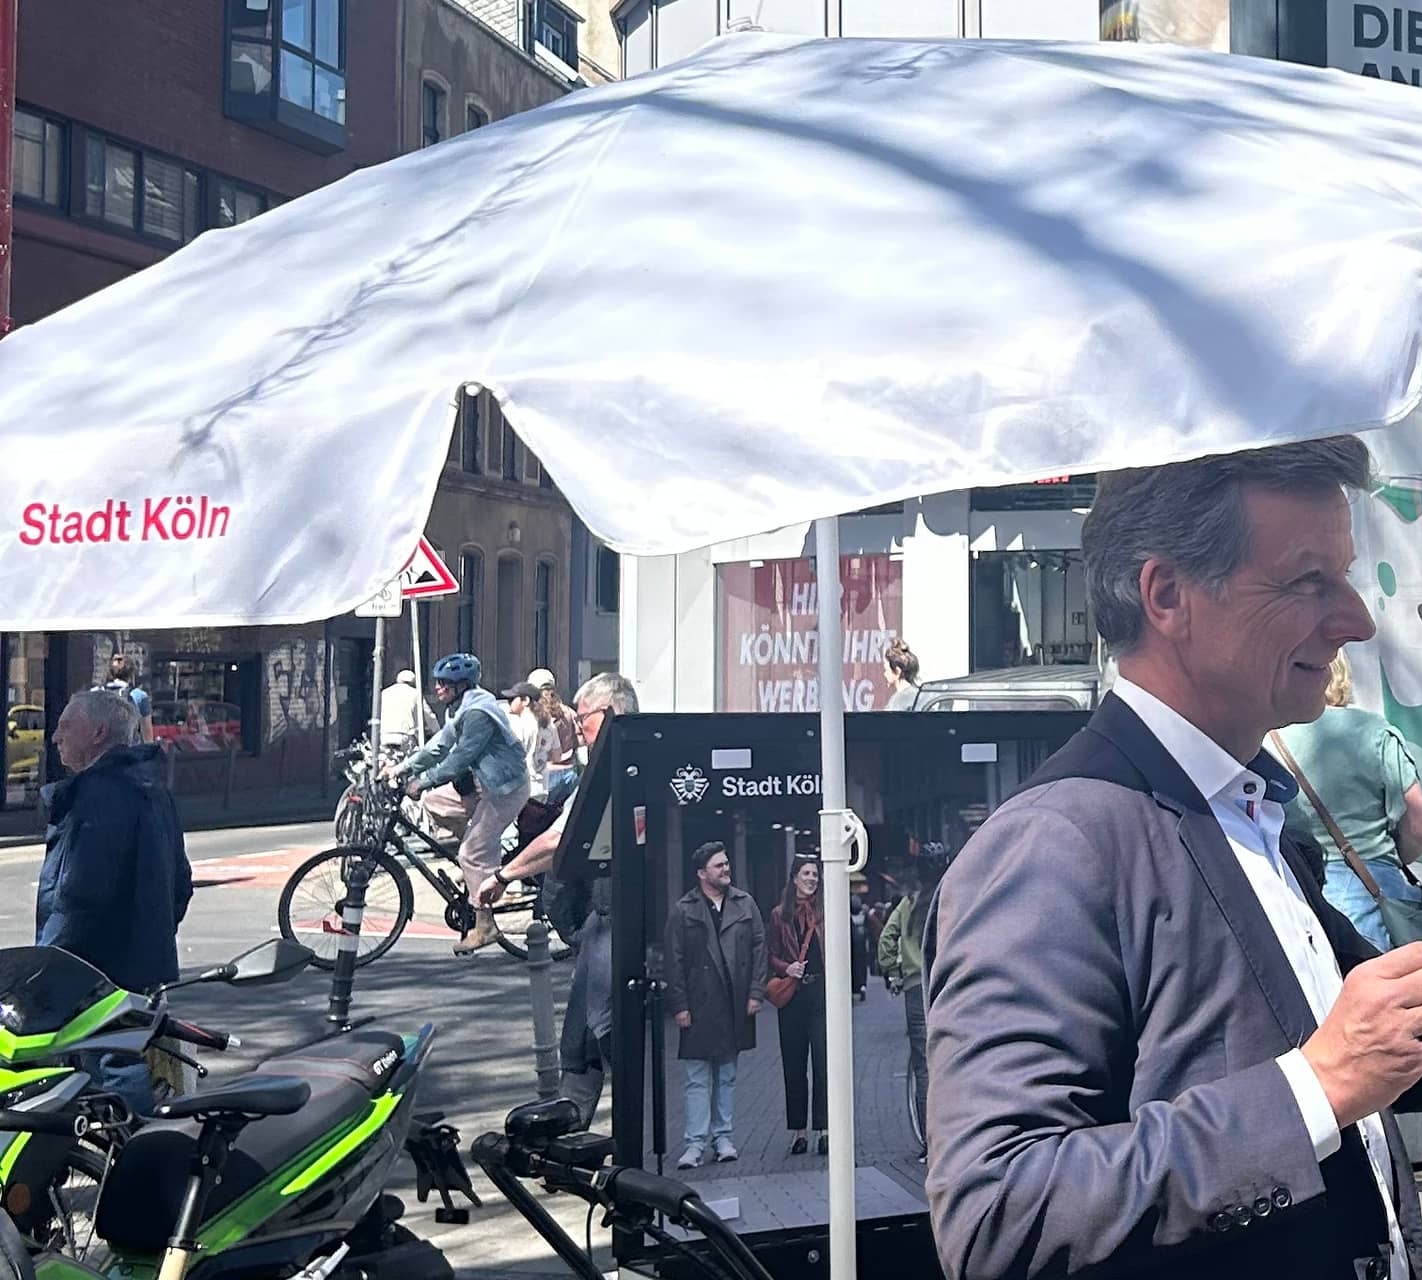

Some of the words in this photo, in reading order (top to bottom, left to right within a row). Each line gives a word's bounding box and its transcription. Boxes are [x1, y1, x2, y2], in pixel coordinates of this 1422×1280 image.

[19, 499, 132, 546] Stadt
[141, 496, 231, 541] Köln
[758, 679, 875, 713] WERBNG
[722, 775, 783, 797] Stadt
[786, 774, 822, 795] Köl
